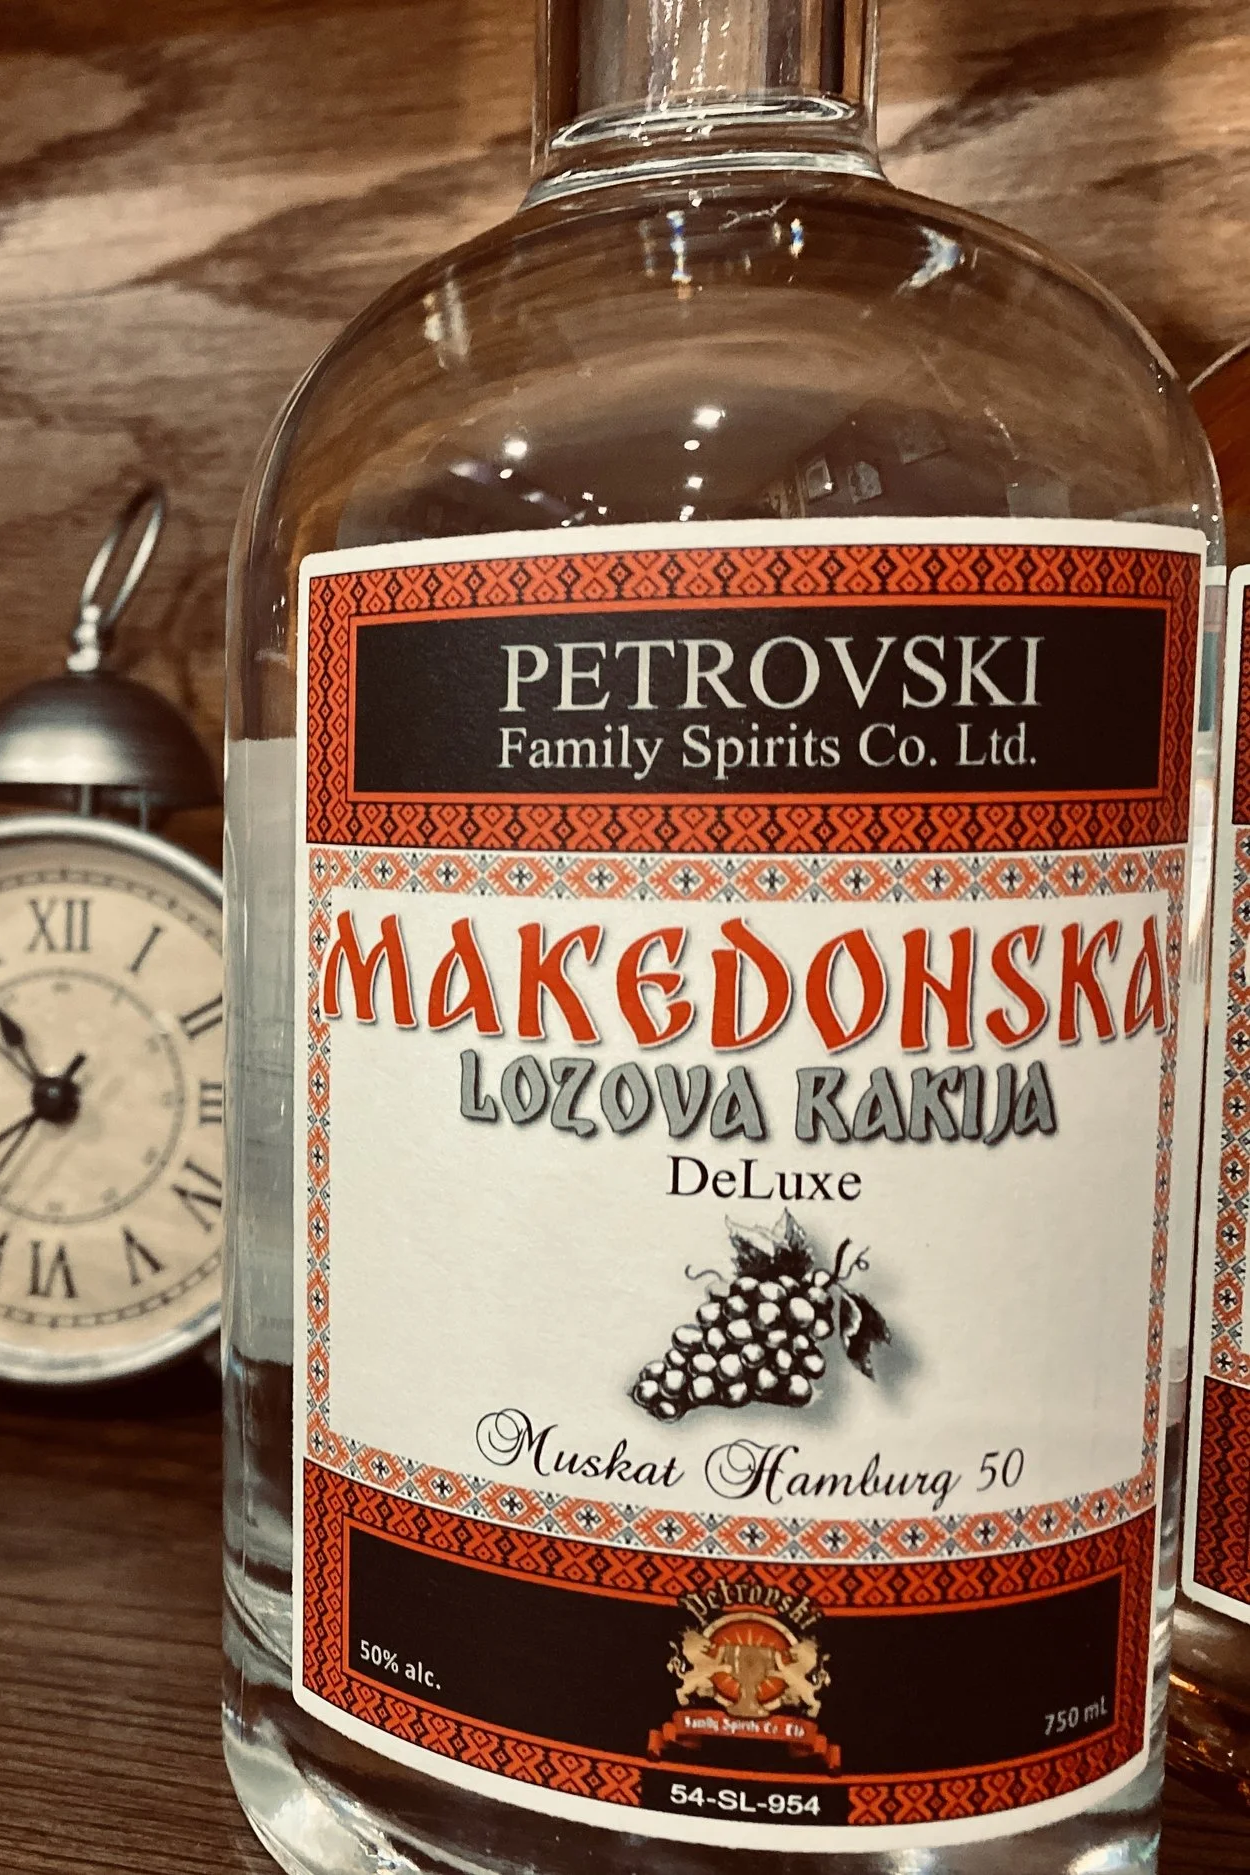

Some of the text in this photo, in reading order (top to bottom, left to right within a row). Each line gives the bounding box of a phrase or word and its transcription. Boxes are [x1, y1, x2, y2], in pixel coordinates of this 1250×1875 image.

[498, 634, 1046, 713] PETROVSKI
[497, 721, 1039, 781] Family Spirits Co. Ltd.
[26, 898, 91, 953] XII
[323, 908, 1168, 1054] MAKEDONSKA
[459, 1048, 1058, 1146] LOZOVA RAKIJA
[667, 1155, 863, 1203] DeLuxe
[28, 1240, 77, 1299] VI
[475, 1408, 1025, 1511] Muskat Hamburg 50
[360, 1639, 441, 1690] 50% alc.
[1044, 1706, 1079, 1736] 750
[670, 1783, 821, 1816] 54-SL-954
